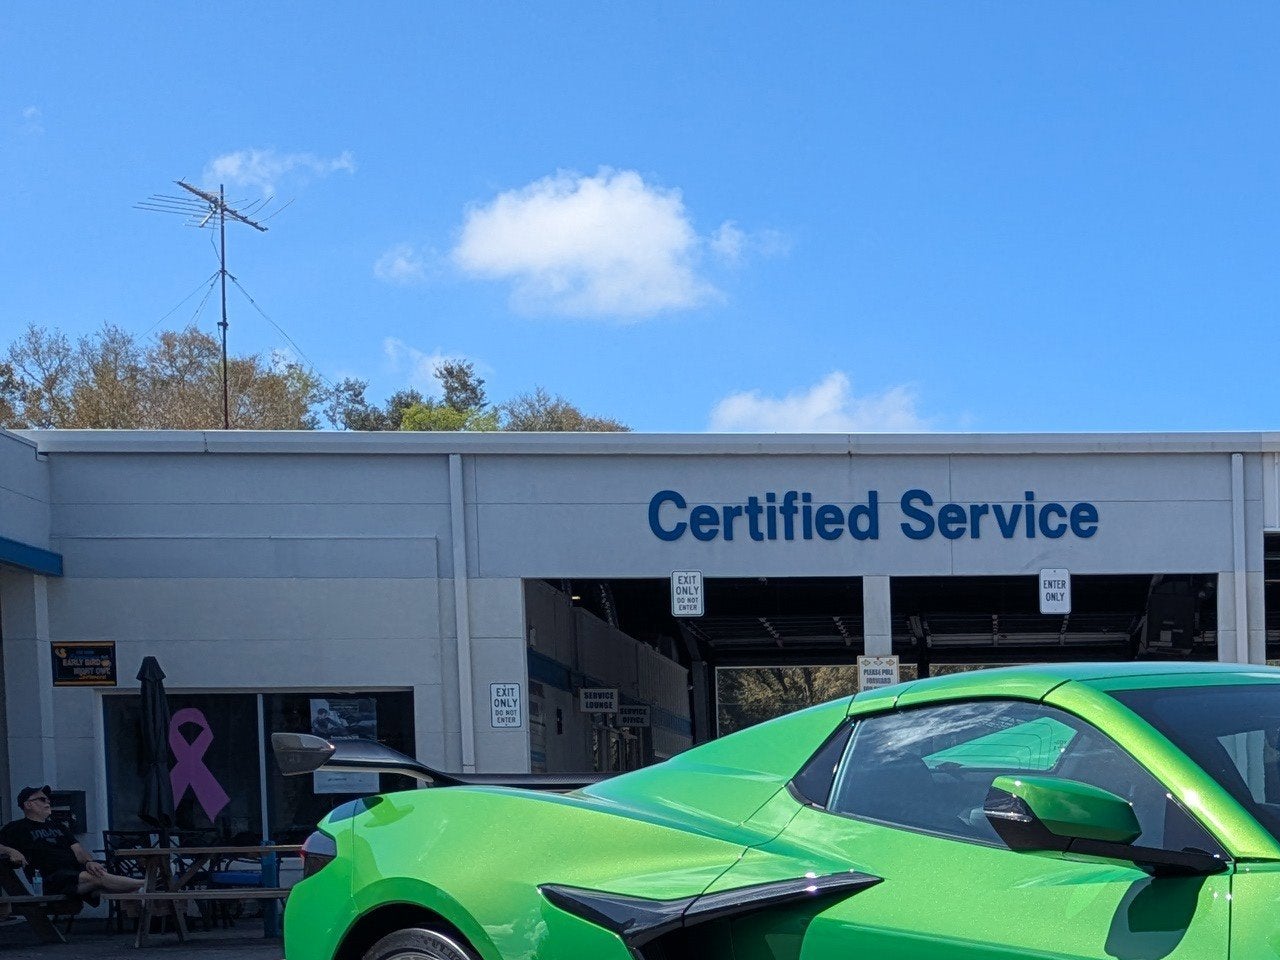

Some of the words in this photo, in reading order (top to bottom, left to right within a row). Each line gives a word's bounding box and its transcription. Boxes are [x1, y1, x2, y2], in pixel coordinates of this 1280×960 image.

[648, 489, 879, 541] Certified
[900, 489, 1099, 540] Service
[677, 575, 696, 585] EXIT
[1043, 579, 1067, 589] ENTER
[675, 586, 700, 596] ONLY
[1045, 592, 1065, 602] ONLY
[863, 668, 881, 676] PLEASE
[496, 687, 515, 697] EXIT
[583, 691, 614, 700] SERVICE
[494, 698, 518, 708] ONLY
[585, 701, 613, 709] LOUNGE
[620, 708, 648, 716] SERVICE
[622, 716, 645, 724] OFFICE
